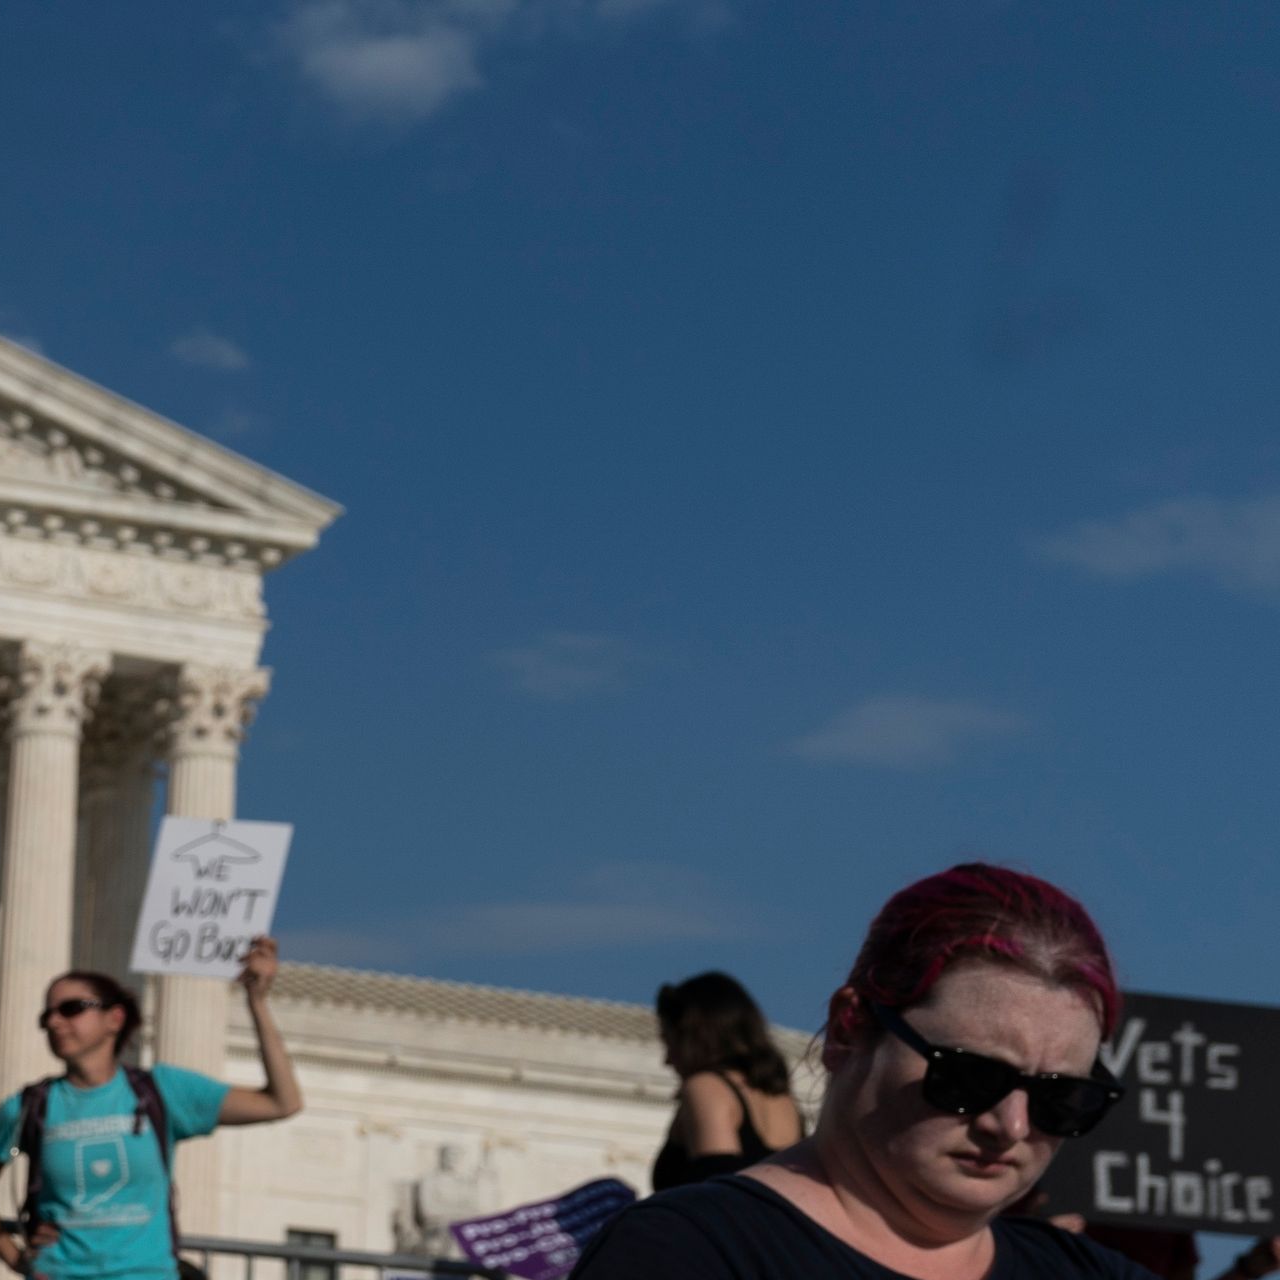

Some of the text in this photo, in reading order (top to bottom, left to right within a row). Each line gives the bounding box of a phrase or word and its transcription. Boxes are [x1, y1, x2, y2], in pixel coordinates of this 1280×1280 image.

[1098, 1016, 1240, 1091] Vets
[1141, 1087, 1186, 1162] 4
[1093, 1150, 1273, 1223] Choice
